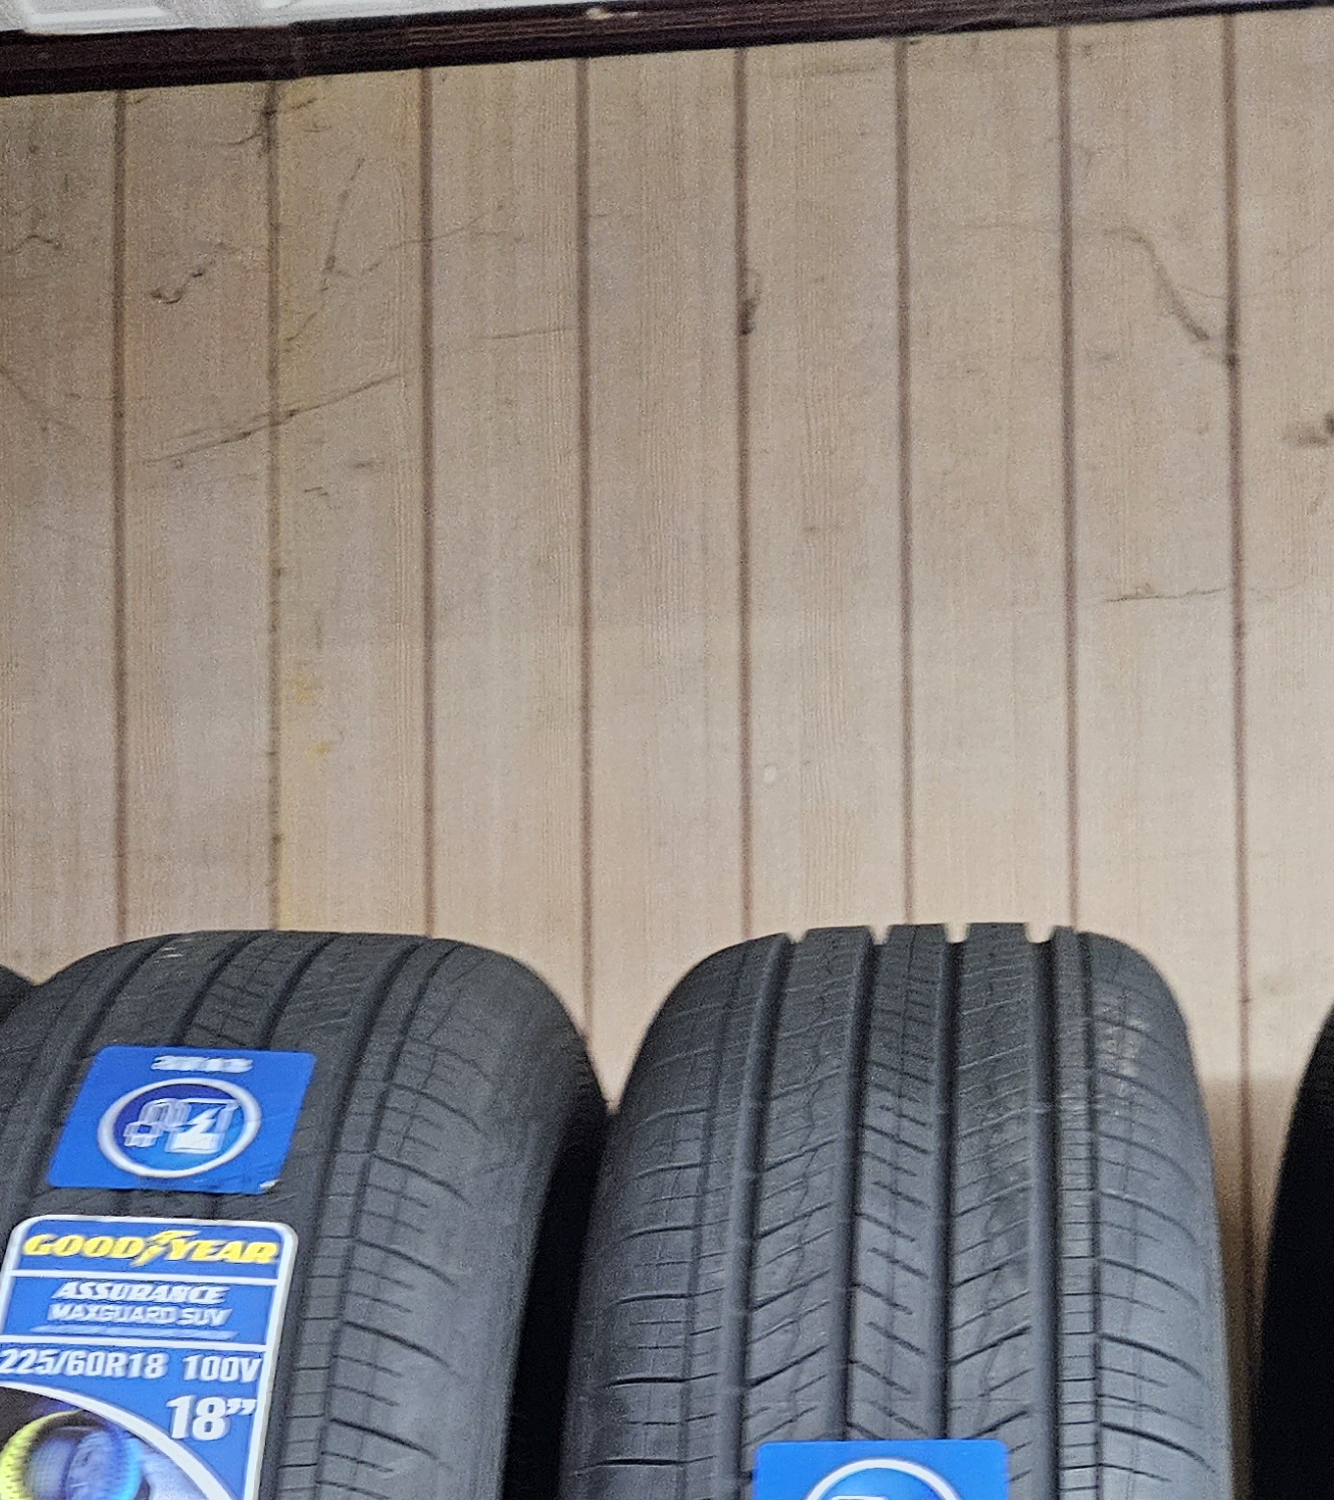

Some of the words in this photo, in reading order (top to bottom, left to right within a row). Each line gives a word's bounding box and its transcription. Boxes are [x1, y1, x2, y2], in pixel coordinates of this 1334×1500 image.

[23, 1230, 280, 1266] GOODYEAR
[51, 1282, 231, 1304] ASSURANCE
[47, 1303, 177, 1324] MAXGUARD
[176, 1307, 233, 1326] SUV
[183, 1355, 263, 1383] 100V
